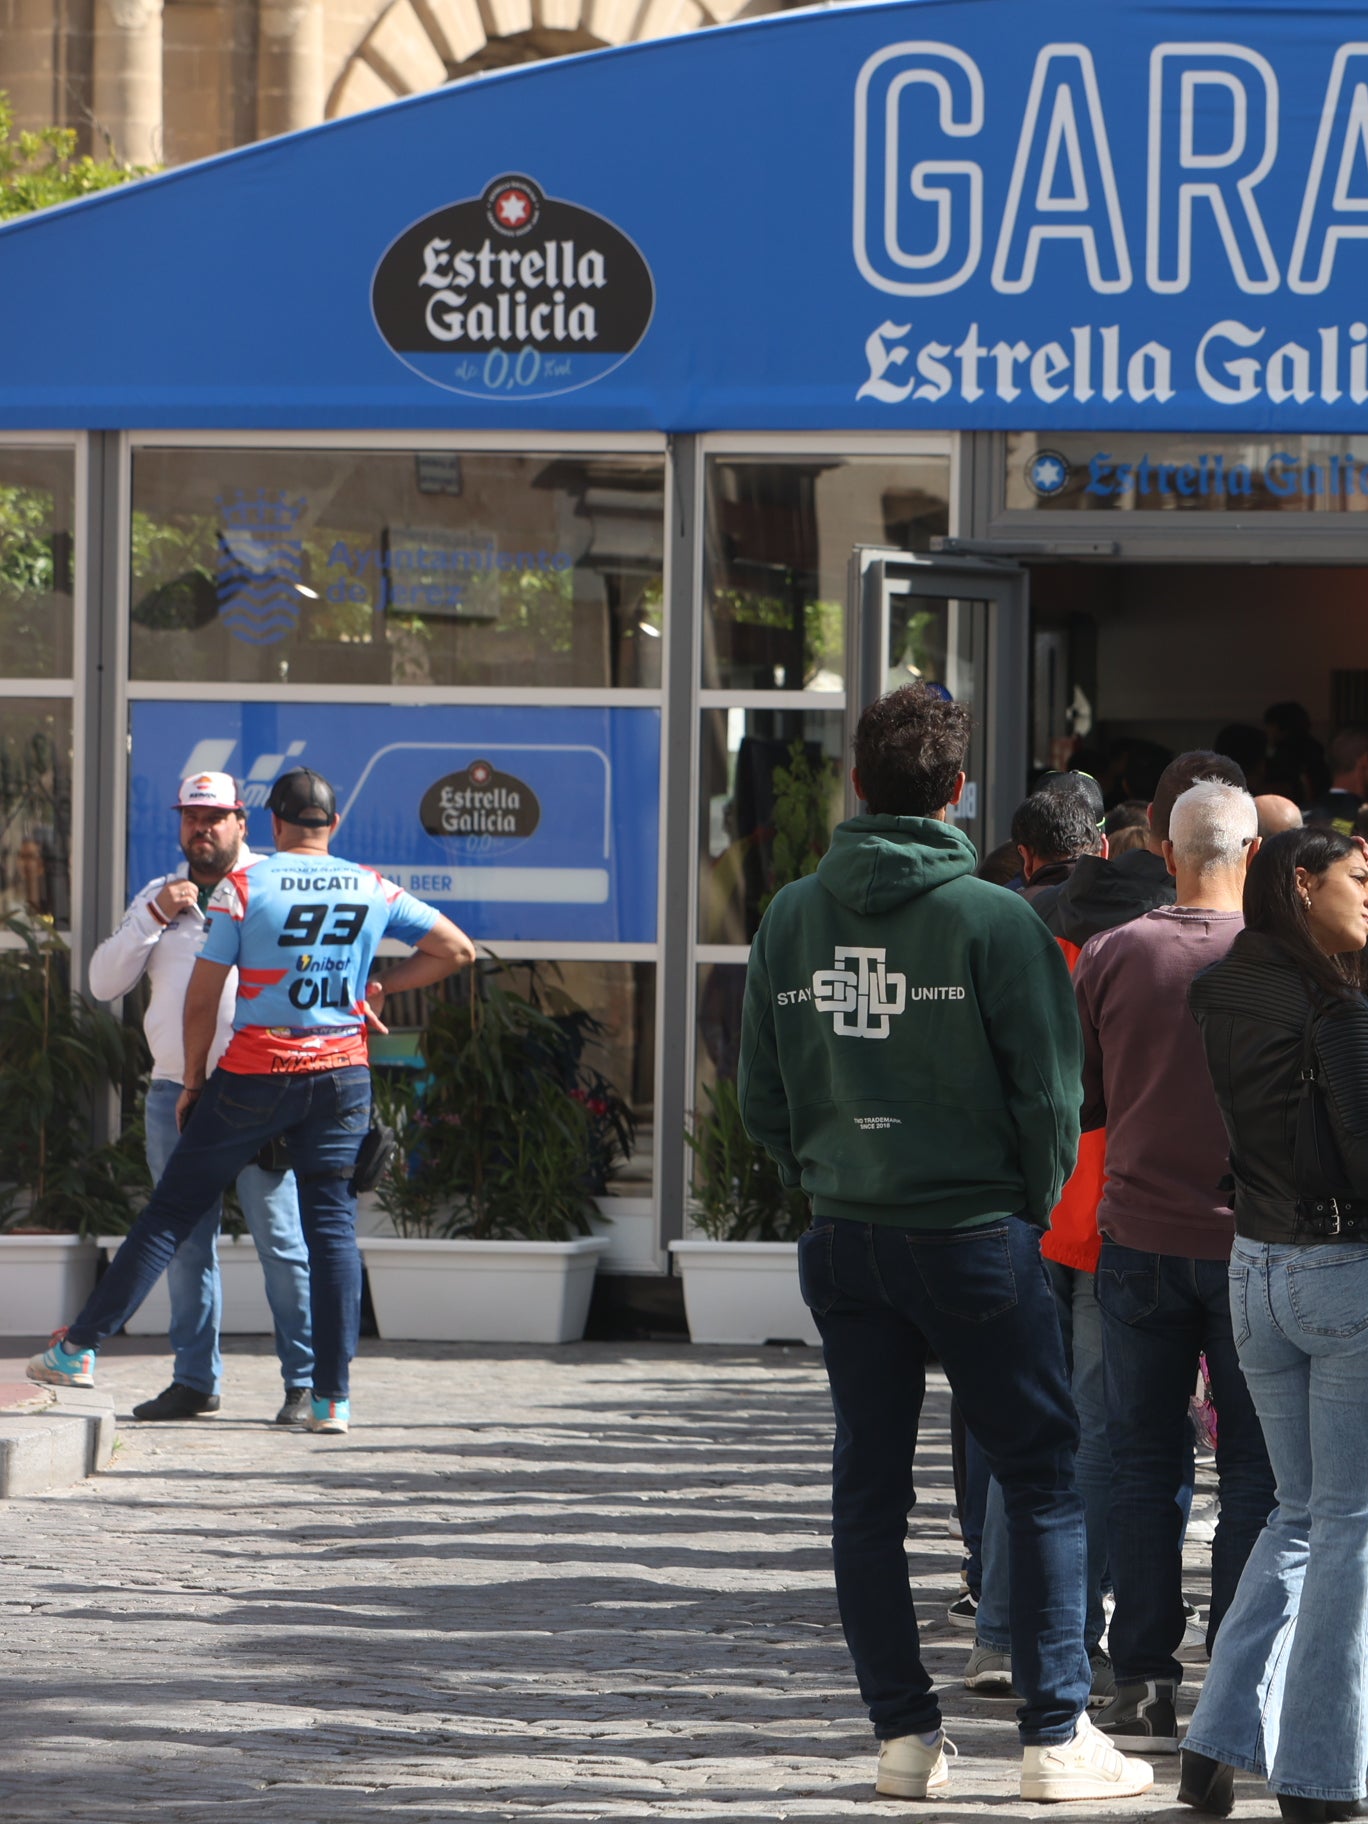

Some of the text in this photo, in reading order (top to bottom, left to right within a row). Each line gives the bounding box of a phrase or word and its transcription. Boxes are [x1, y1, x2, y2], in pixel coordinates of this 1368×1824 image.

[419, 237, 607, 288] Estrella
[425, 289, 598, 341] Galicia
[483, 345, 541, 390] 0,0
[856, 319, 1176, 405] Estrella
[1084, 452, 1253, 496] Estrella
[327, 540, 573, 576] Ayuntamiento
[326, 576, 462, 611] de Jerez
[439, 786, 520, 809] Estrella
[441, 809, 516, 832] Galicia
[280, 876, 358, 891] DUCATI
[410, 875, 452, 891] BEER
[278, 903, 369, 947] 93
[296, 954, 350, 972] Unibat
[777, 986, 966, 1006] STAY UNITED
